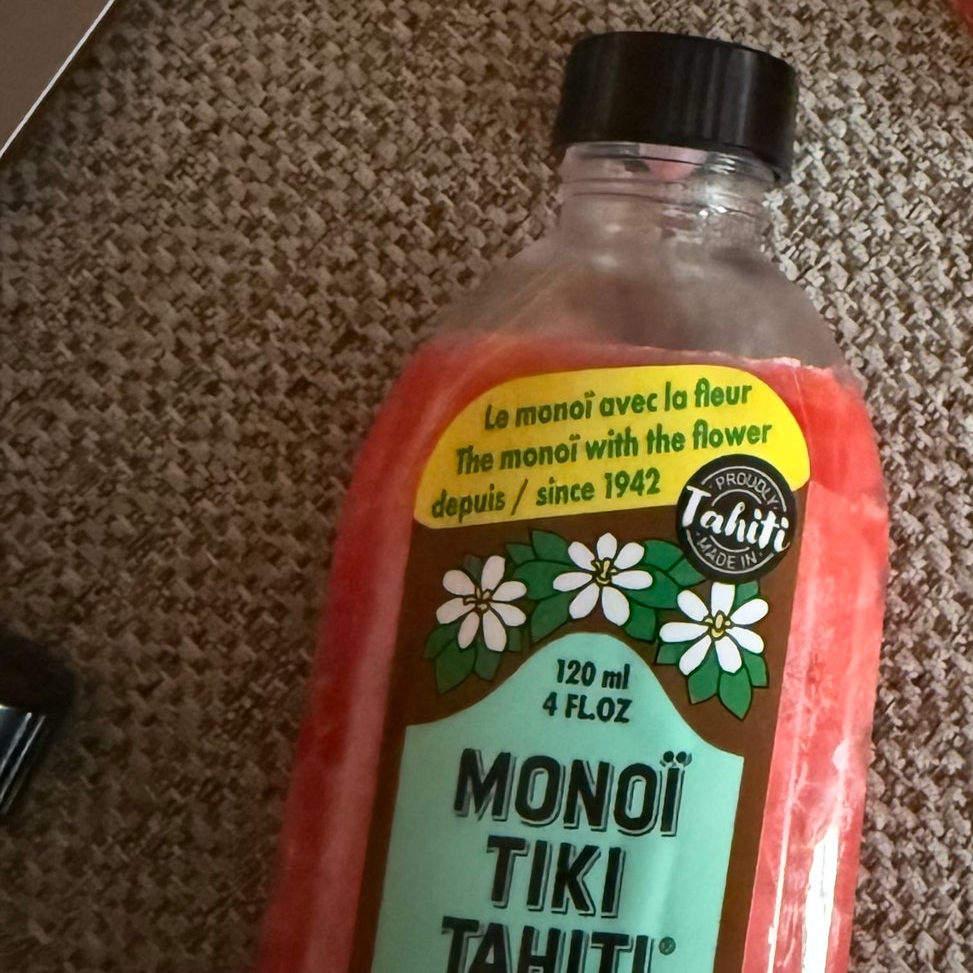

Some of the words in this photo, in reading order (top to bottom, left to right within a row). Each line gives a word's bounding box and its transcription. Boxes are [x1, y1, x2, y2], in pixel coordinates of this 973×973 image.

[484, 403, 509, 431] Le
[515, 389, 596, 428] monoï
[600, 388, 657, 417] avec
[665, 381, 688, 411] la
[694, 377, 753, 408] fleur
[456, 446, 495, 476] The
[500, 434, 580, 472] monoï
[586, 424, 639, 461] with
[646, 423, 685, 453] the
[692, 419, 773, 450] flower
[431, 488, 506, 523] depuis
[510, 479, 529, 516] /
[535, 476, 596, 507] since
[604, 467, 661, 500] 1942
[715, 472, 779, 505] PROUDLY
[682, 485, 790, 552] Tahiti
[697, 537, 736, 570] MADE
[740, 551, 757, 568] IN
[556, 658, 597, 687] 120
[601, 663, 631, 690] ml
[542, 691, 558, 717] 4
[453, 747, 693, 838] MONOÏ
[485, 834, 626, 919] TIKI
